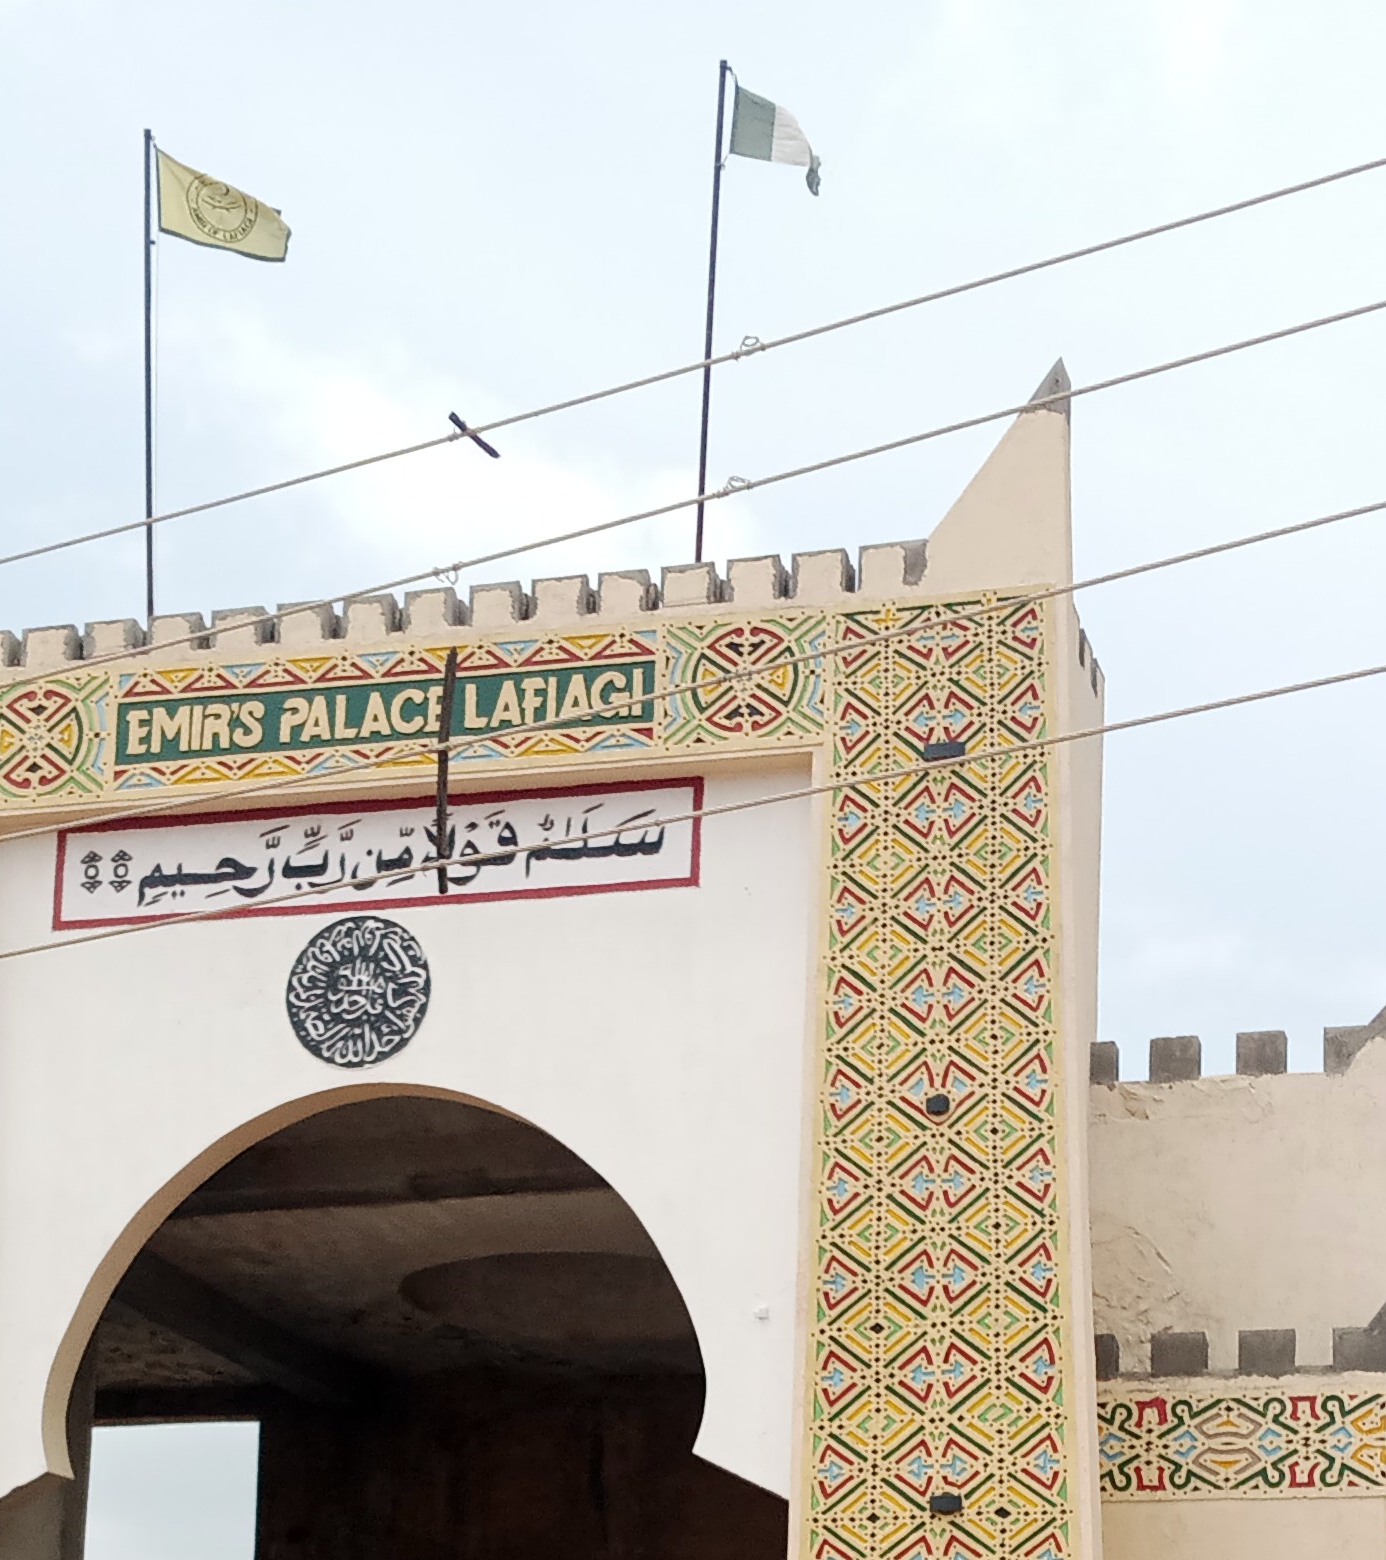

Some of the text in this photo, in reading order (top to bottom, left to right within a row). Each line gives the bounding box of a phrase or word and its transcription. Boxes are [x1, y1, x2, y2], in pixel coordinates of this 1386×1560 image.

[125, 668, 644, 755] EMIR'S PALACE LAFIAGI
